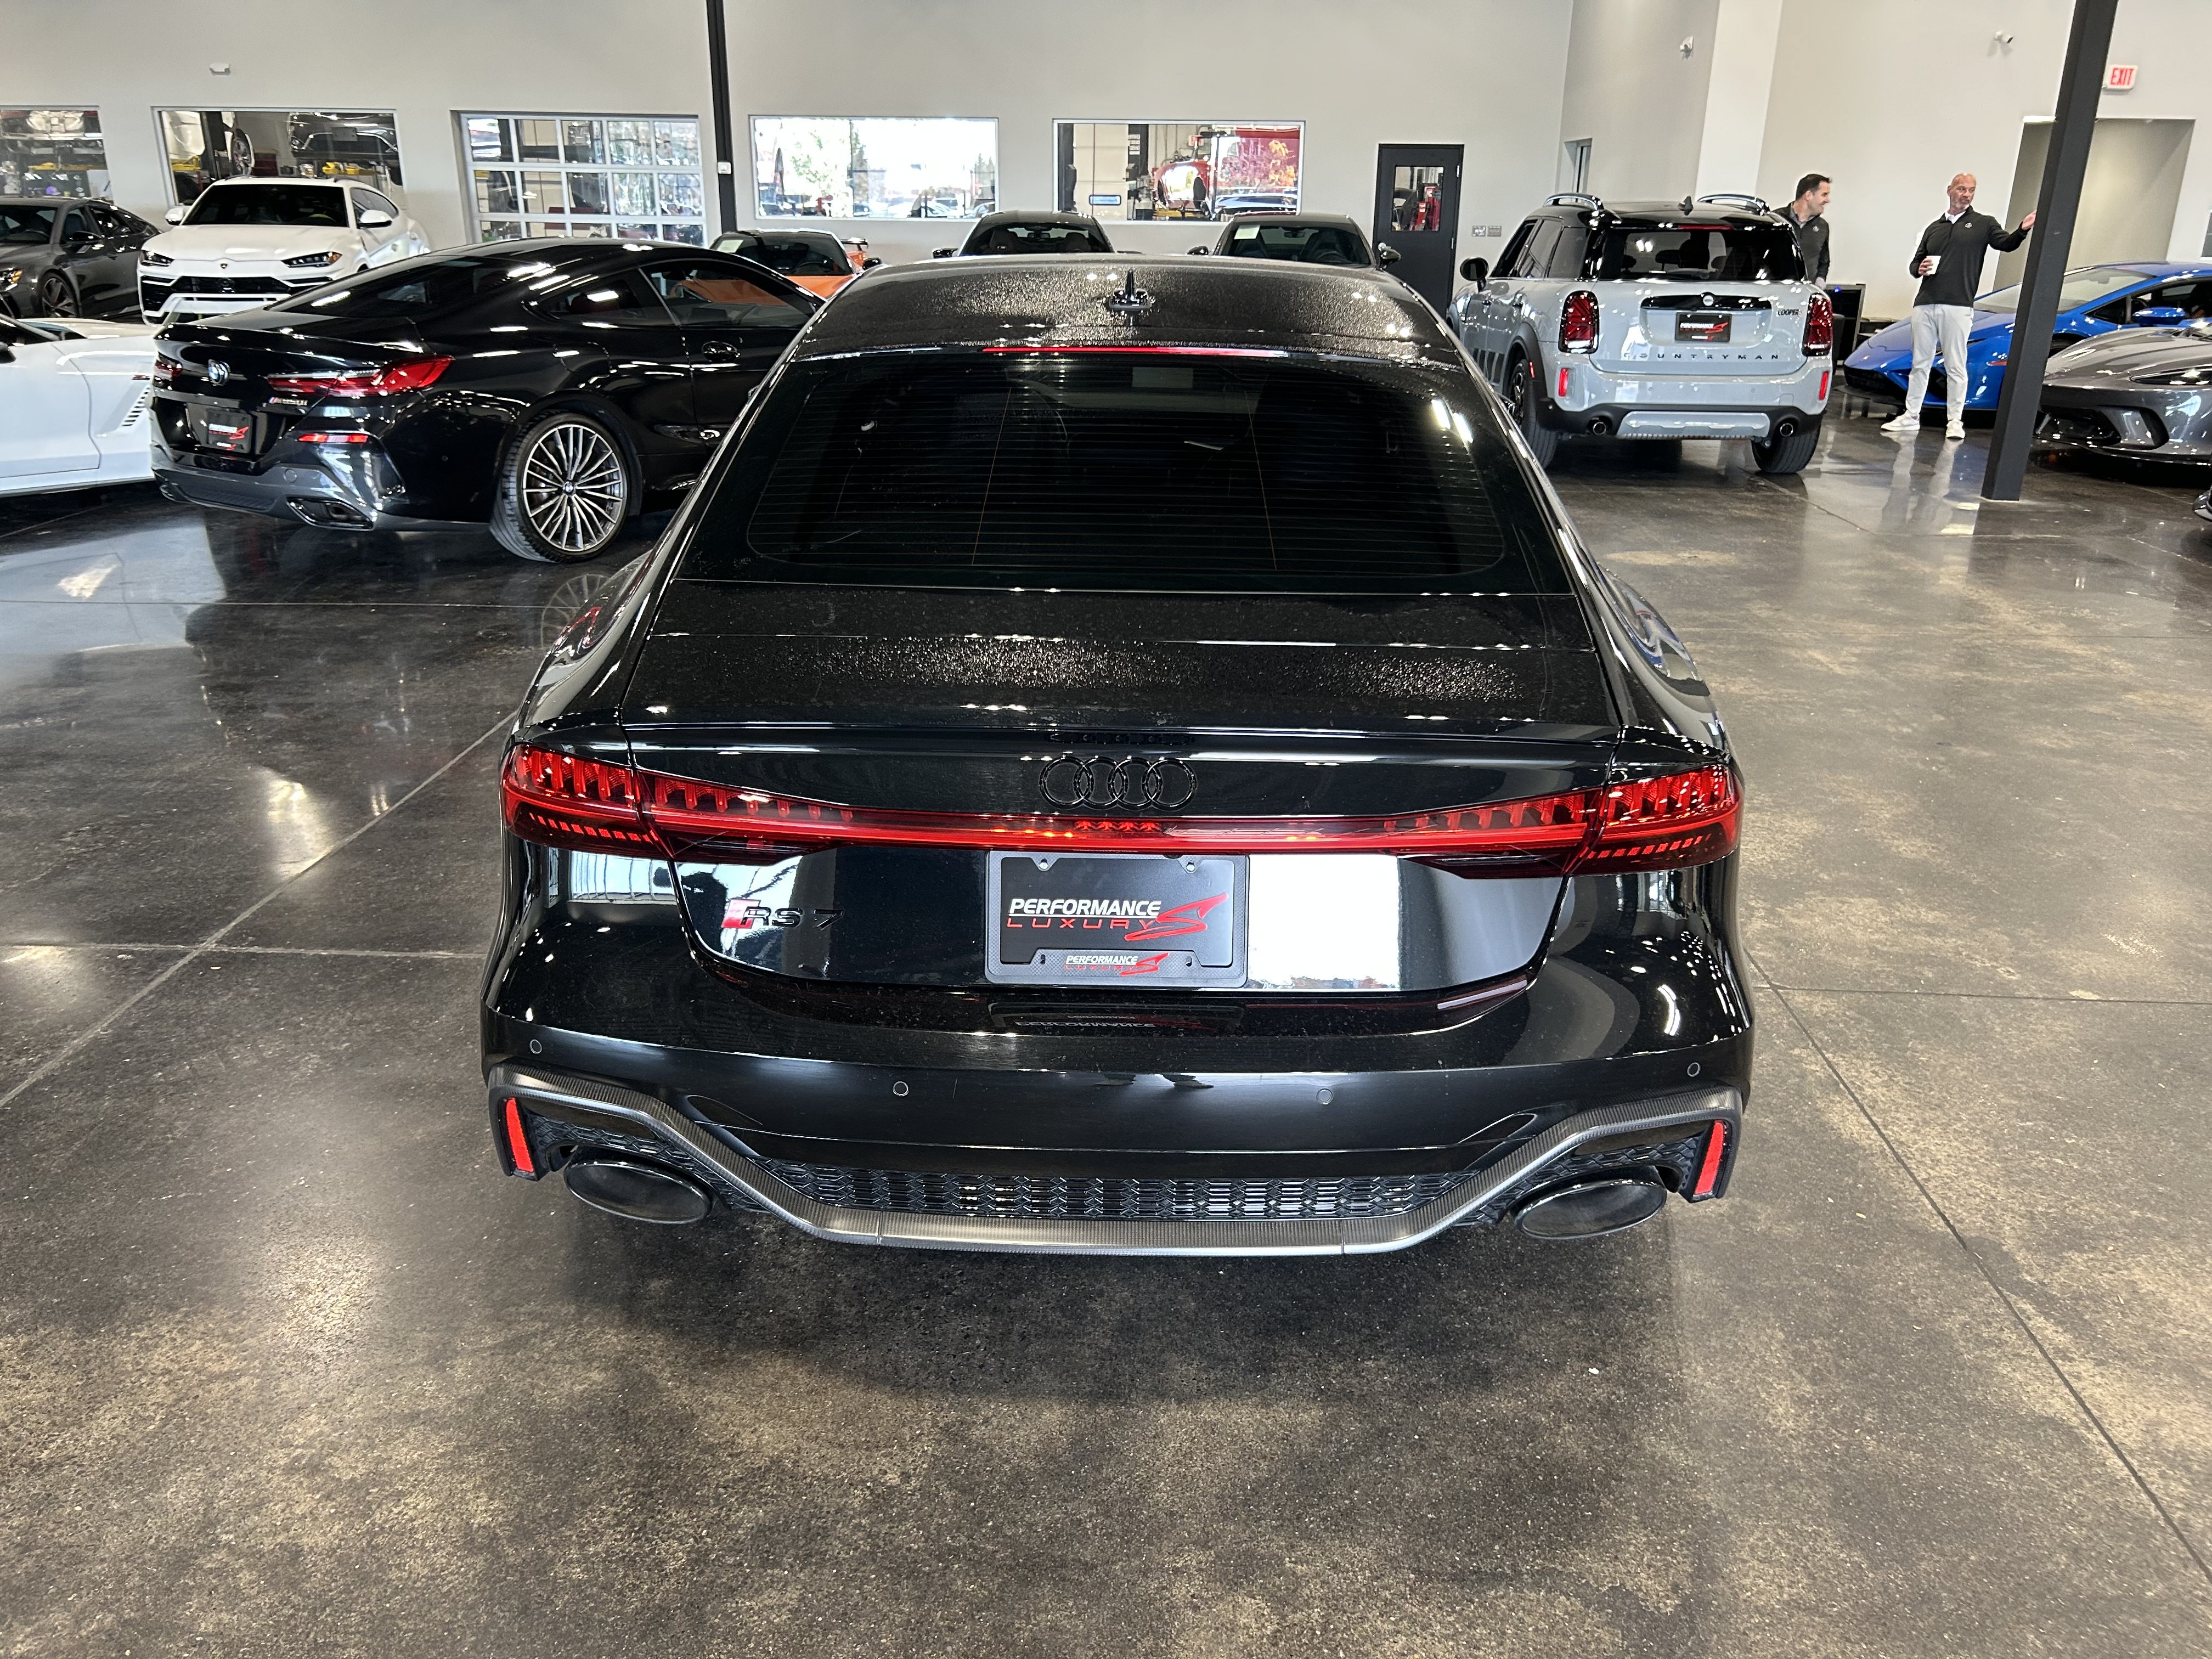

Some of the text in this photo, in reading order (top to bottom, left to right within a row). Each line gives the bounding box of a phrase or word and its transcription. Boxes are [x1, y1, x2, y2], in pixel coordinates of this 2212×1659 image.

[2111, 67, 2134, 85] EXIT
[1009, 898, 1162, 916] PERFORMANCE
[1007, 917, 1155, 929] LUXURY
[1066, 955, 1138, 964] PERFORMANCE
